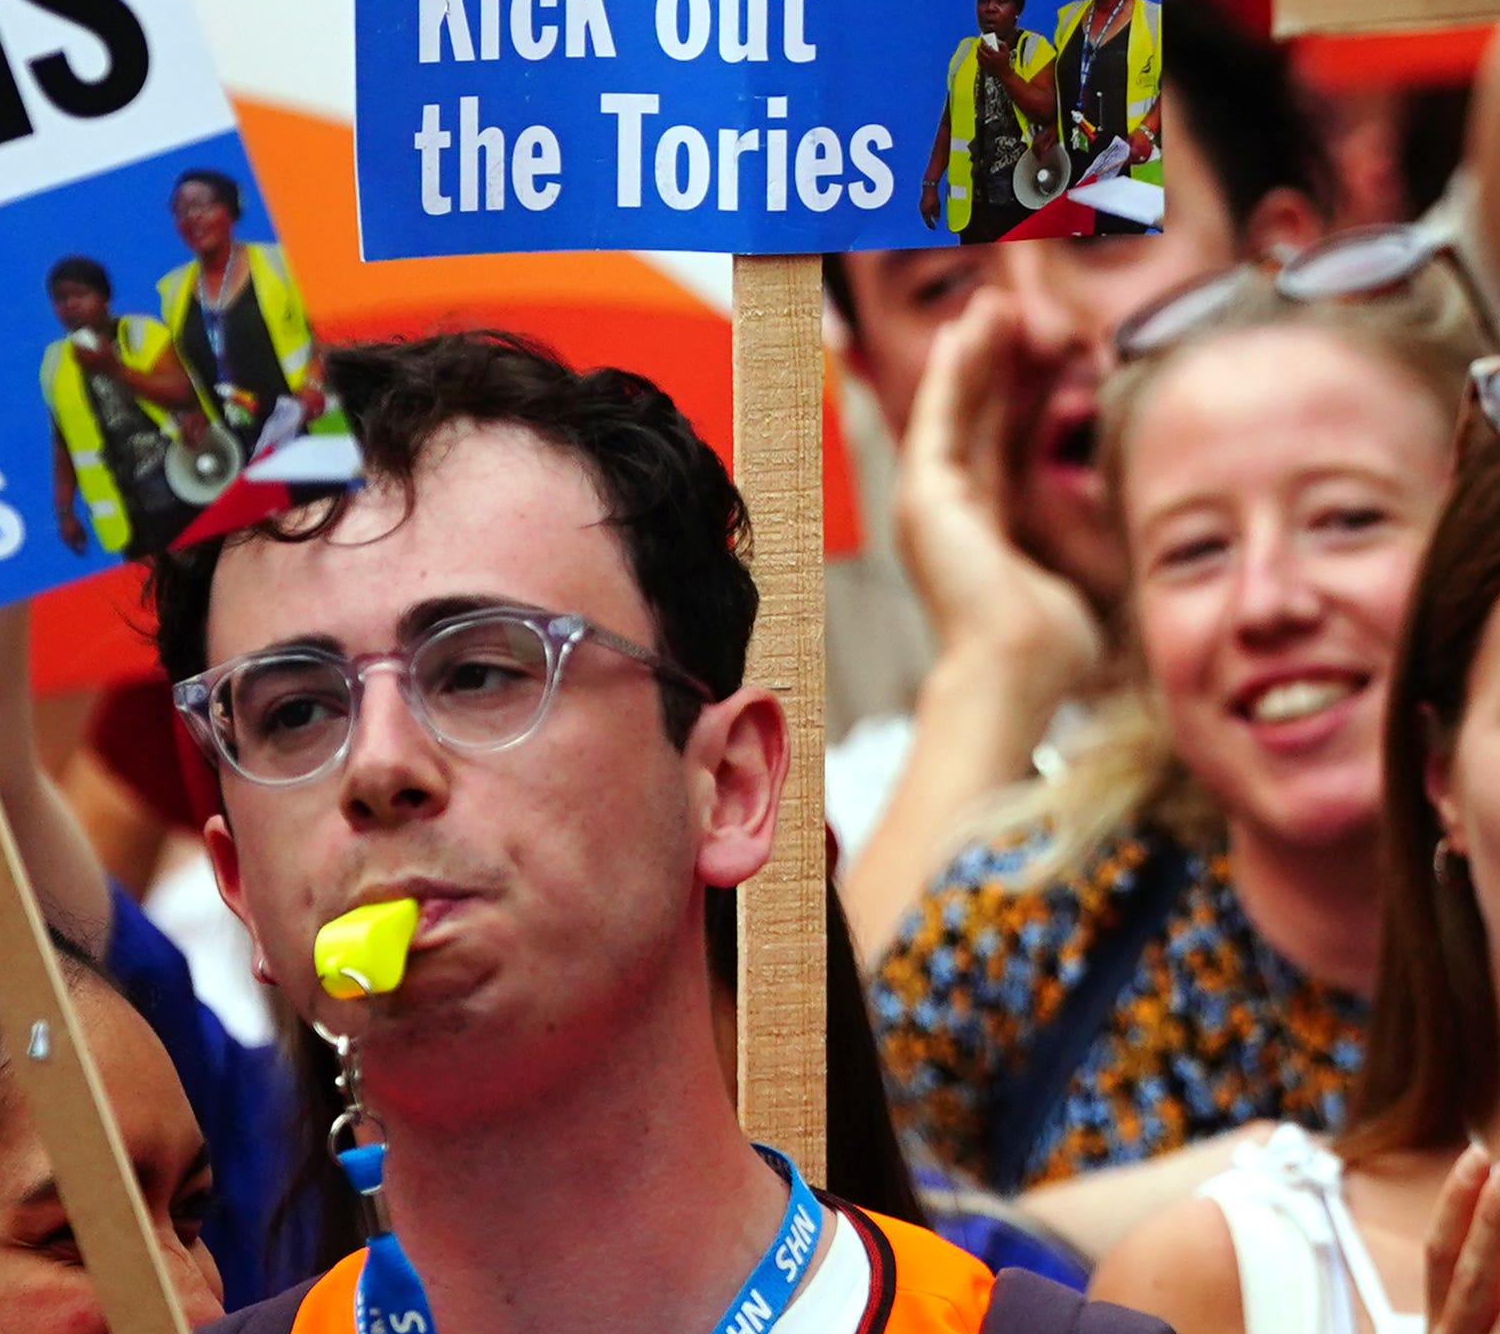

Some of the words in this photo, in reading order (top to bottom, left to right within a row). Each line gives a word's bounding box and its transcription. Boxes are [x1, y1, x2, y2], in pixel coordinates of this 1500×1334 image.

[415, 96, 562, 216] the
[601, 92, 895, 213] Tories
[774, 1204, 817, 1283] NHS
